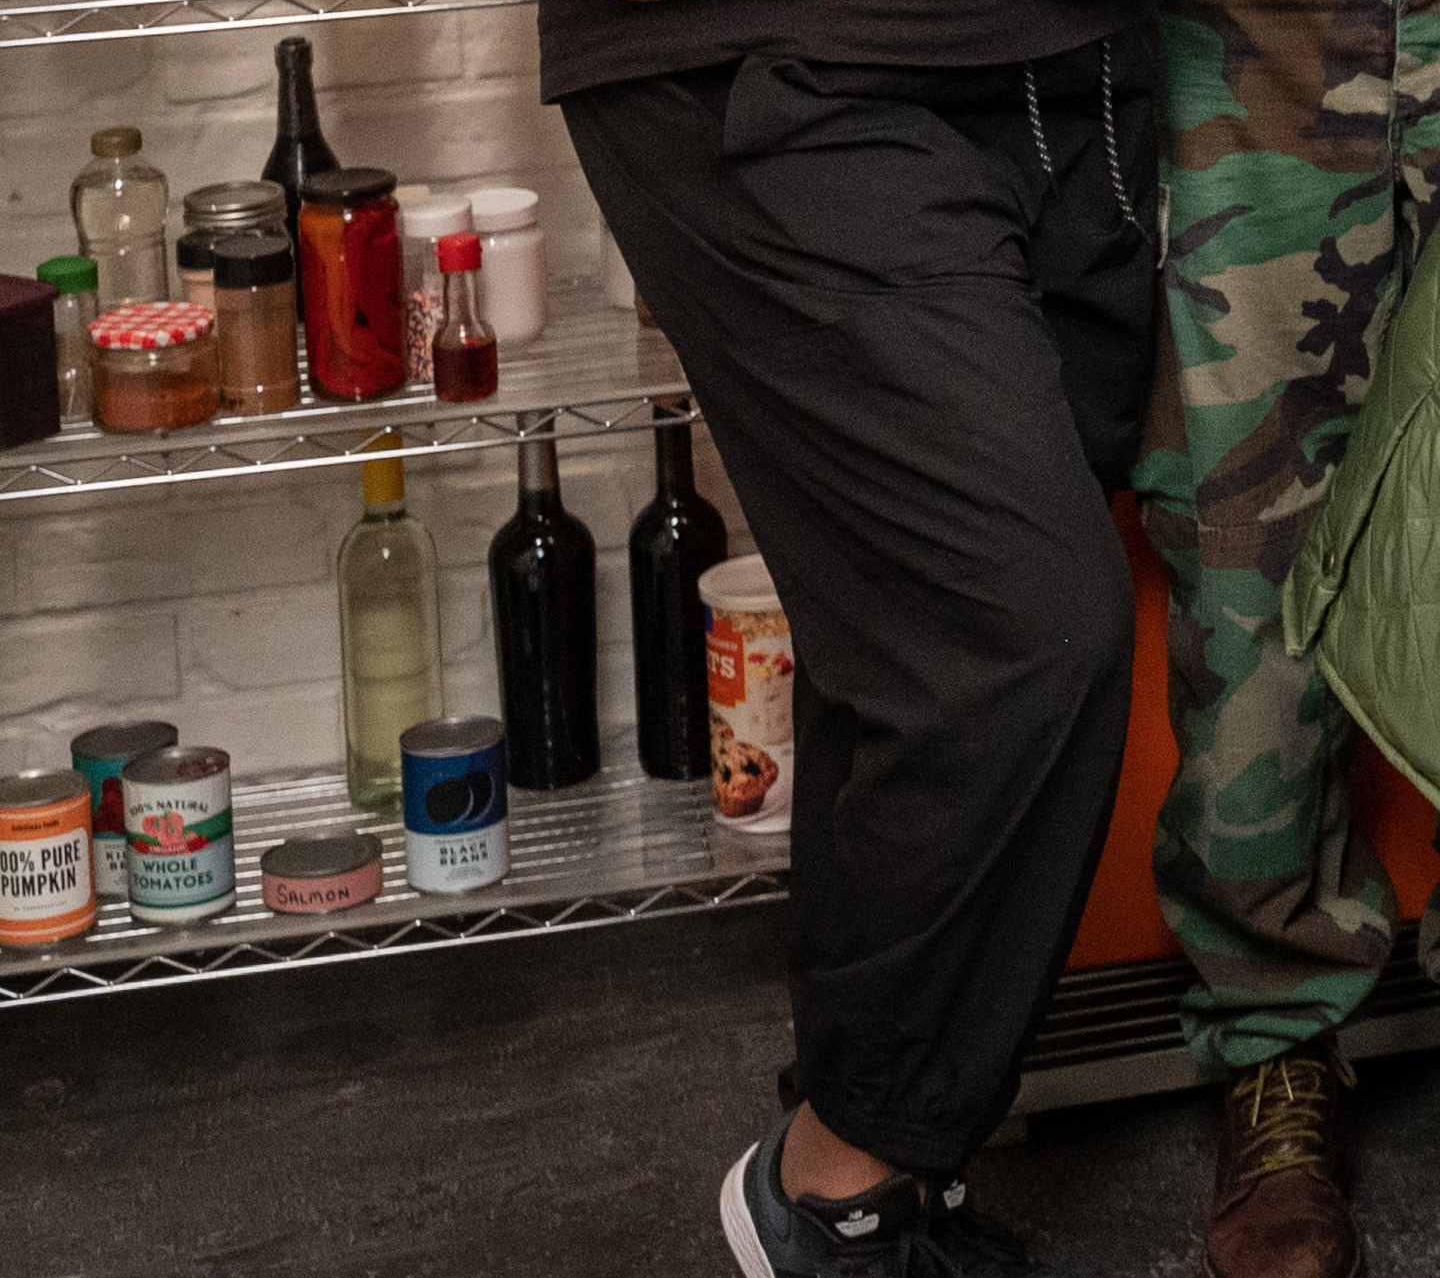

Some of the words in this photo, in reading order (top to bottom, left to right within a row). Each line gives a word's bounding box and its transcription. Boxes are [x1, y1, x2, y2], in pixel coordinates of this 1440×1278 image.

[0, 850, 35, 873] 00%
[40, 839, 81, 870] PURE
[142, 857, 198, 874] WHOLE
[1, 866, 77, 897] PUMPKIN
[132, 870, 213, 891] TOMATOES
[276, 883, 350, 905] SALMON
